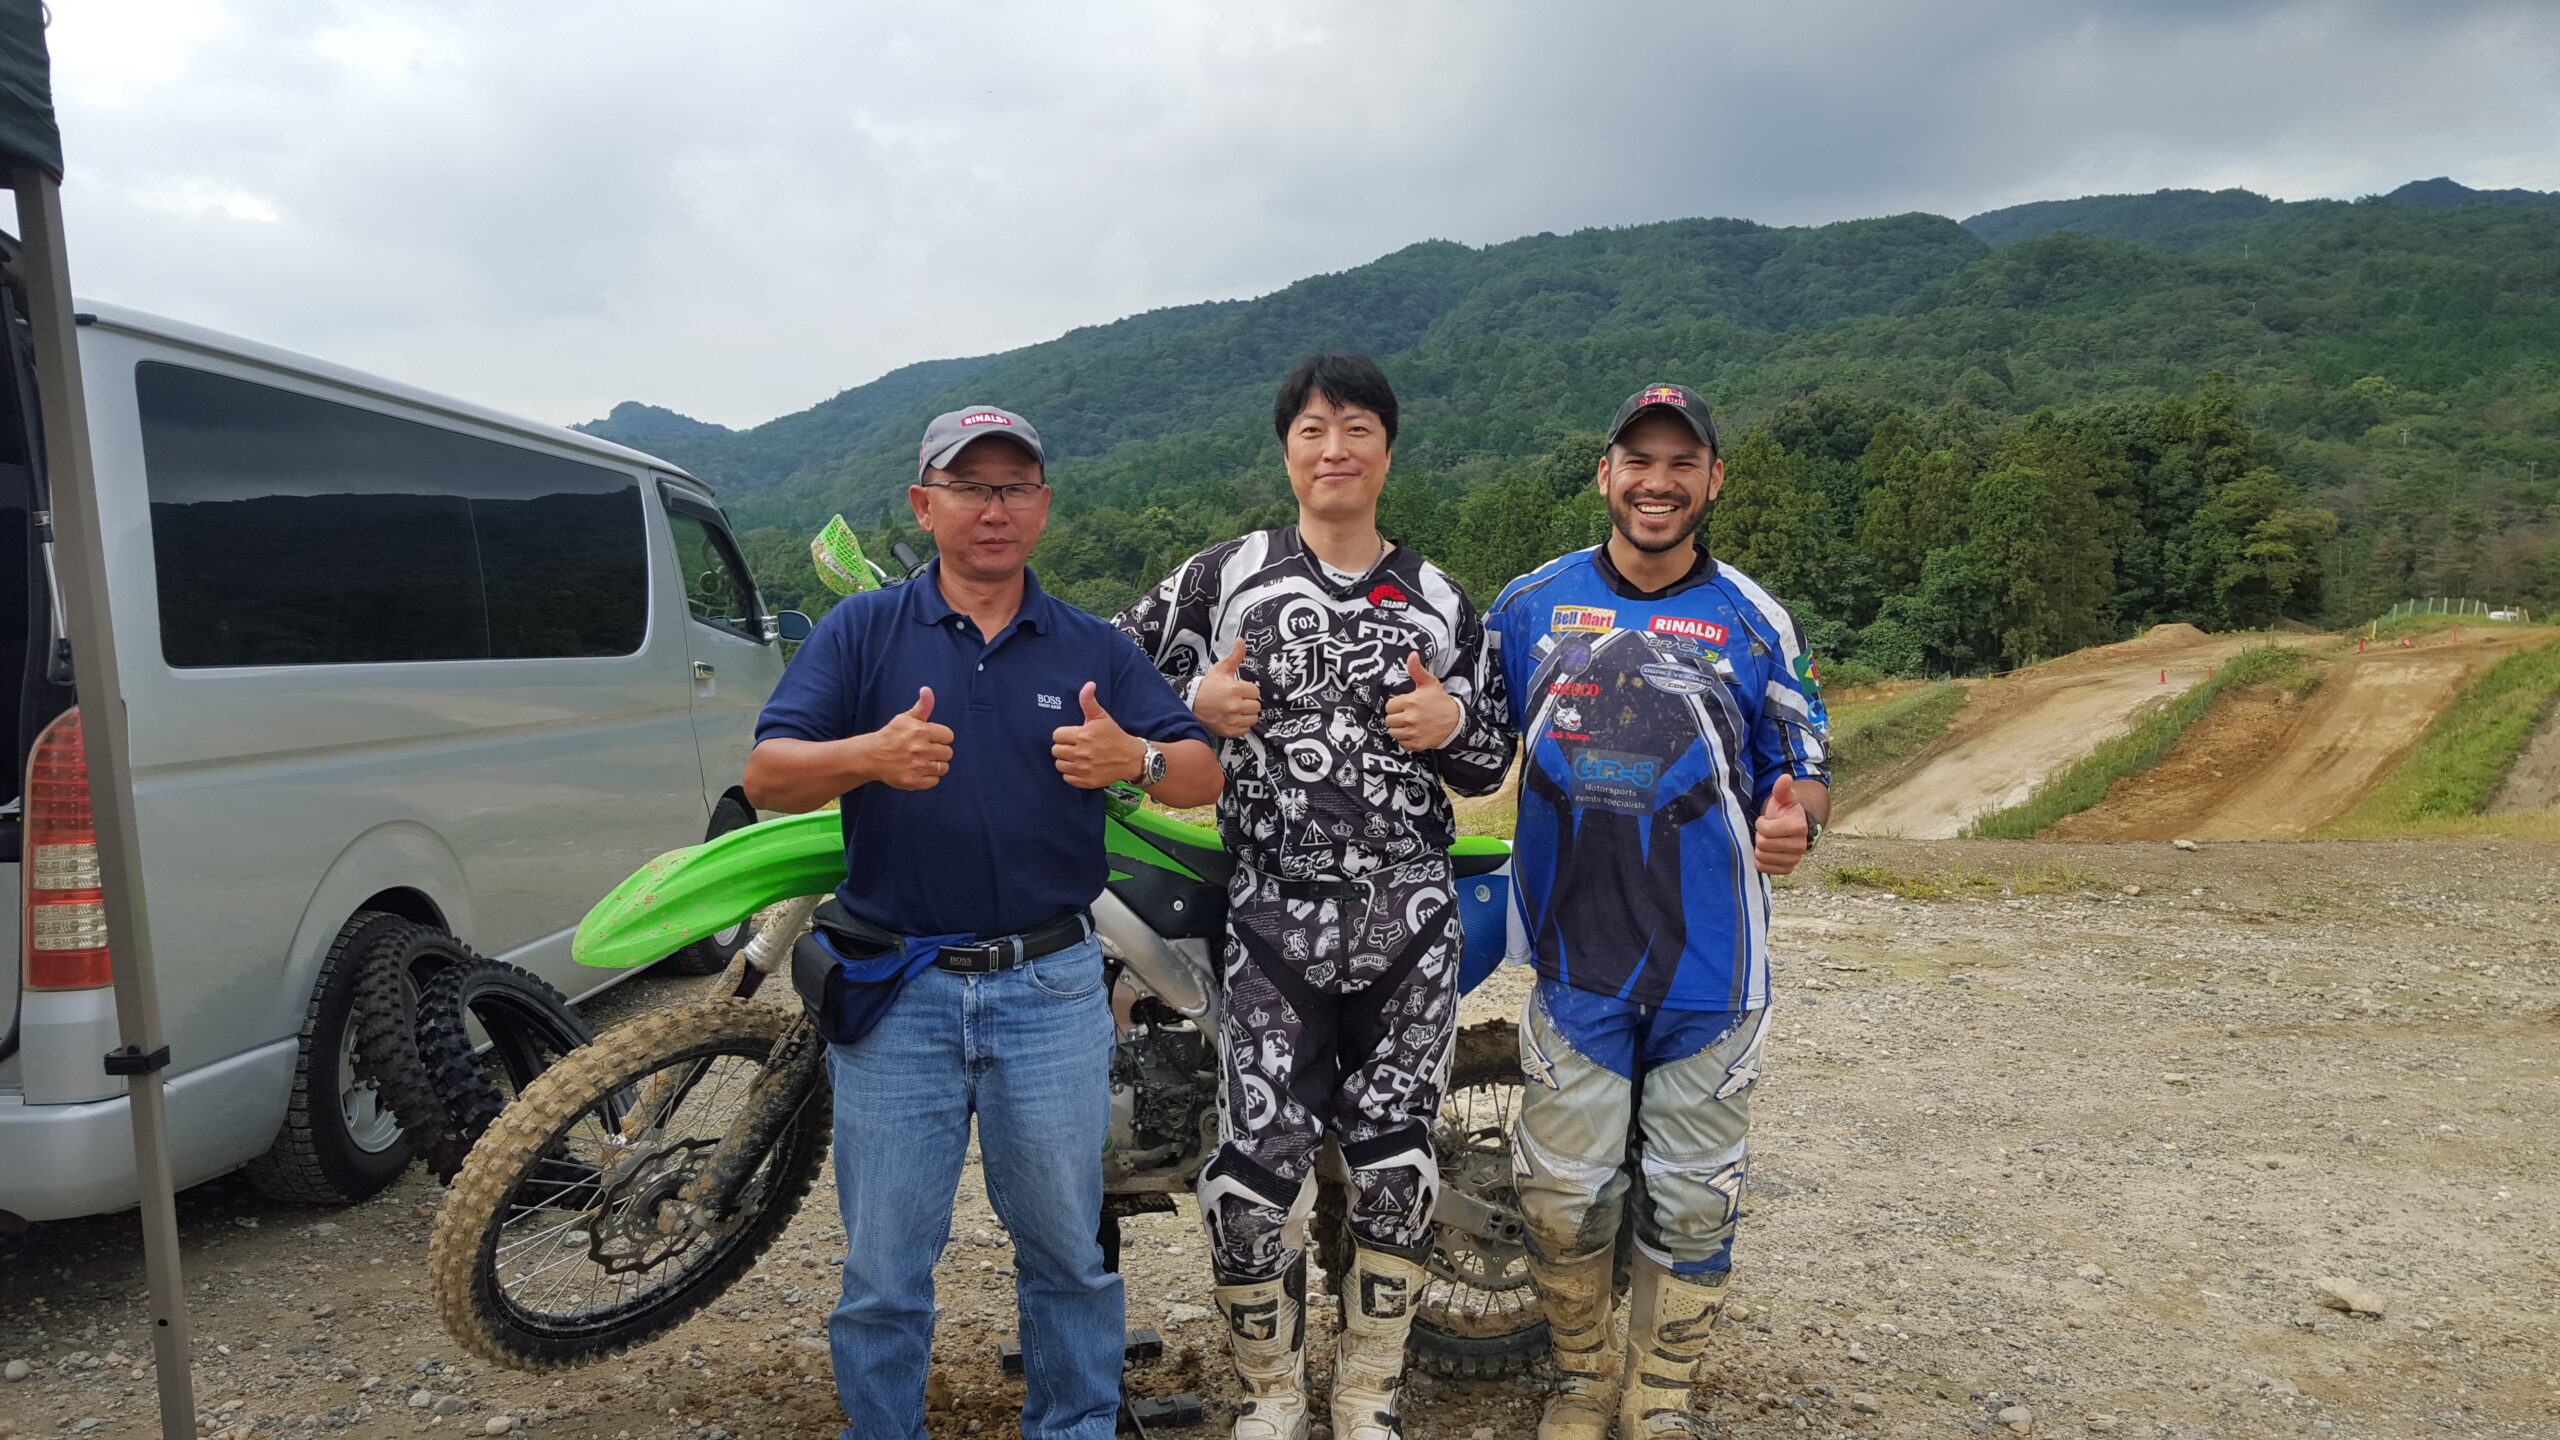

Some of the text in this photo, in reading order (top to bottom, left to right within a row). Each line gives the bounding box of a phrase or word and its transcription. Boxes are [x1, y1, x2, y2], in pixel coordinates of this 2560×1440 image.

[1332, 573, 1355, 582] FOX
[1380, 599, 1409, 609] TRADING
[1290, 614, 1318, 632] FOX
[1555, 611, 1613, 627] Bell Mart
[1357, 620, 1420, 650] FOX
[1648, 638, 1703, 656] BRASIL
[1037, 694, 1062, 705] BOSS
[1362, 752, 1413, 773] FOX
[1584, 783, 1637, 797] Motorsports
[1576, 795, 1647, 809] events specialists
